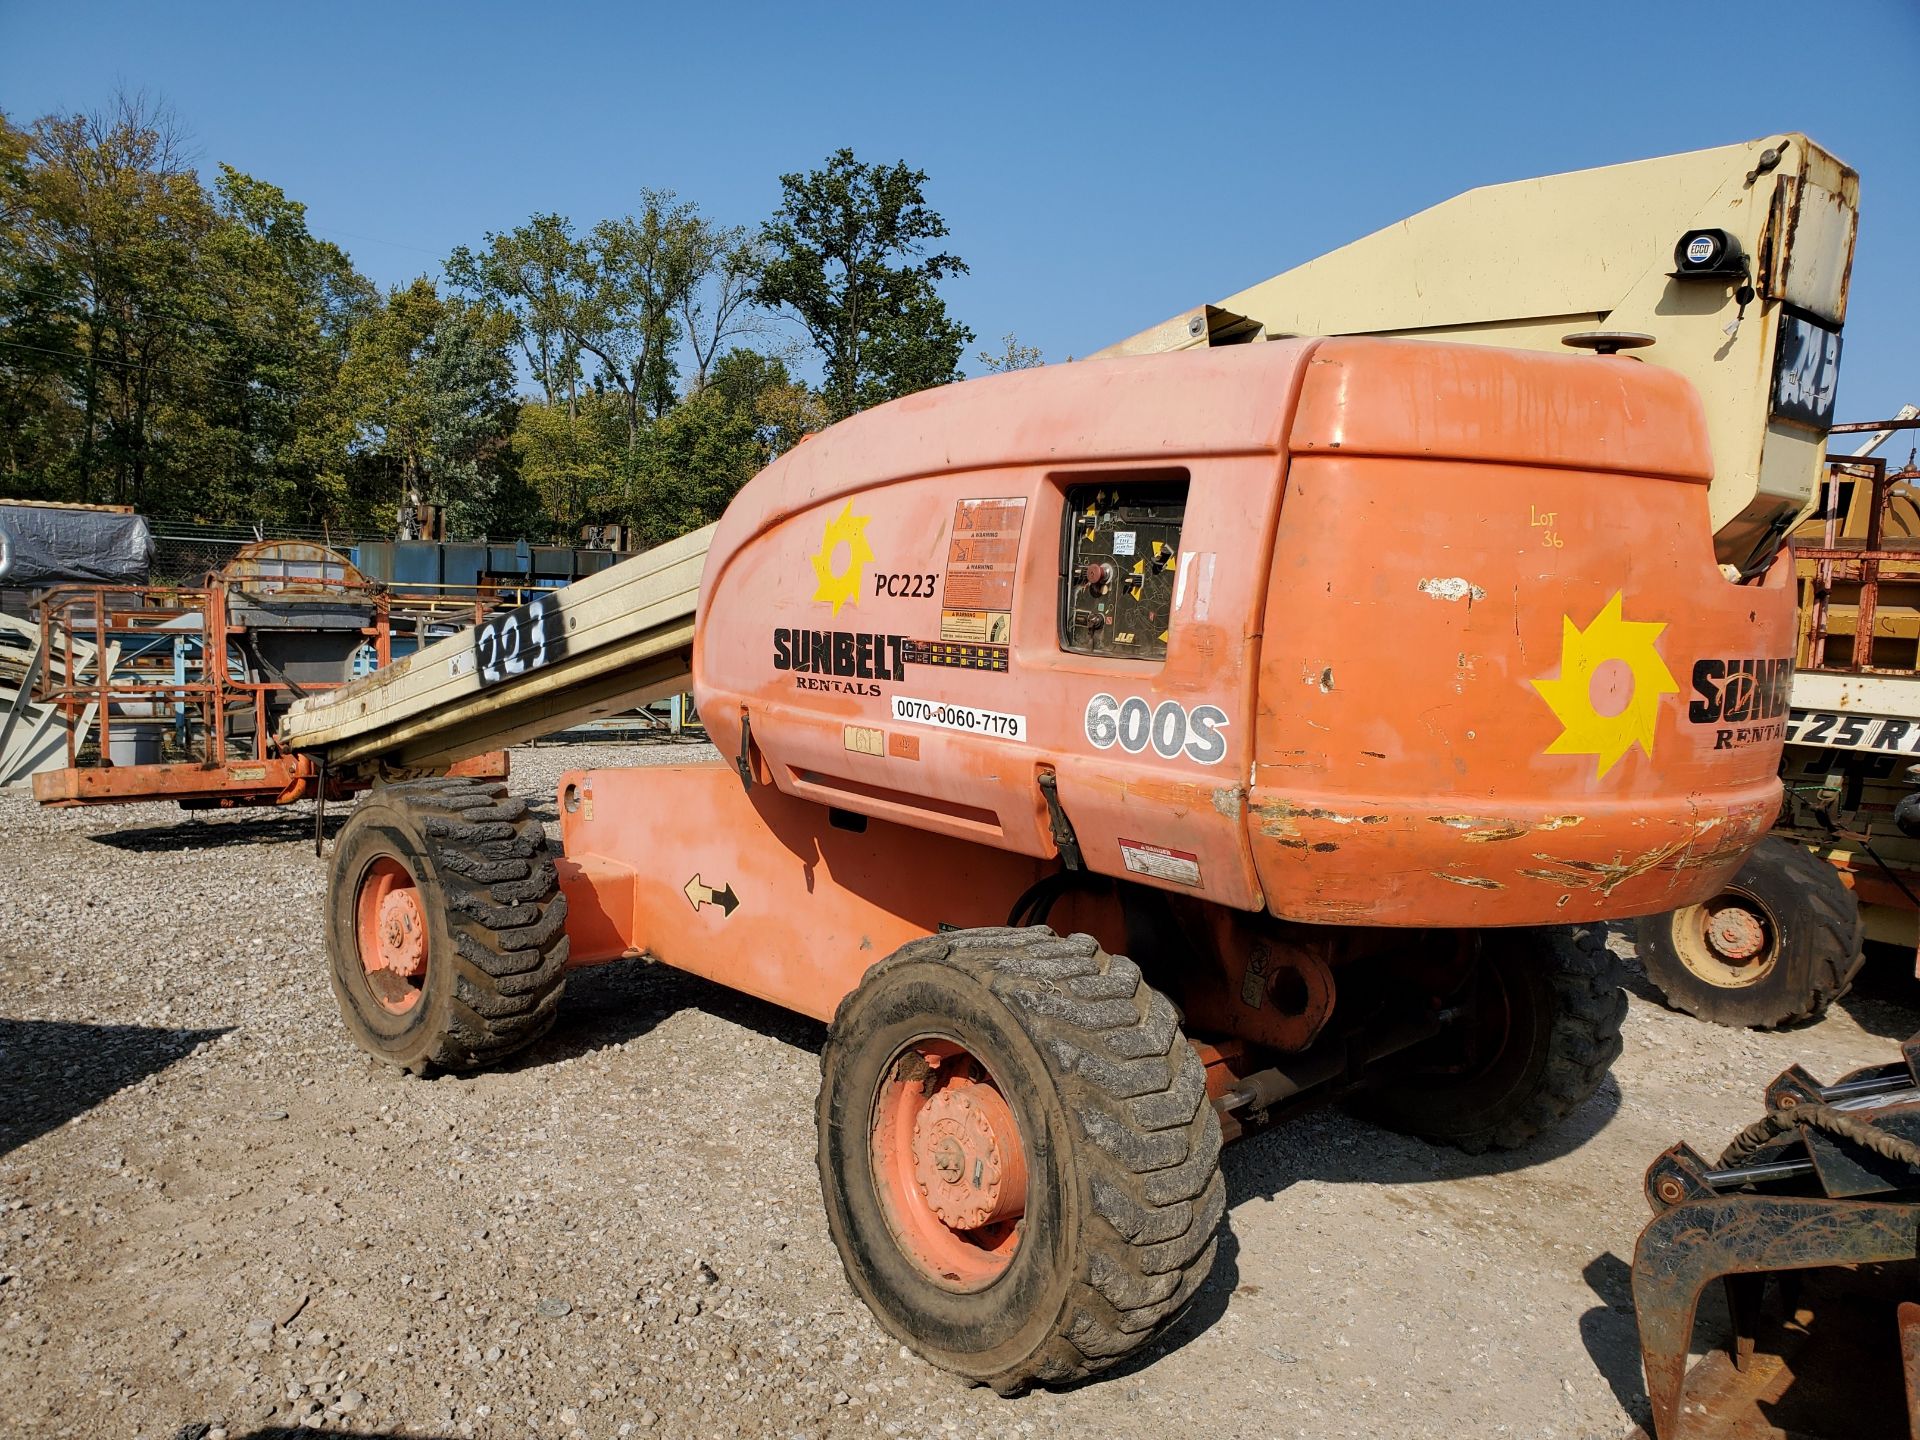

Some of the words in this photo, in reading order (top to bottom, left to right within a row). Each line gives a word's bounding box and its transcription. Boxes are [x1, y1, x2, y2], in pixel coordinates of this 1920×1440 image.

[1690, 244, 1710, 254] ECCO
[1541, 530, 1564, 548] 36
[478, 601, 547, 682] 223
[1115, 632, 1135, 643] JLG
[773, 628, 910, 682] SUNBELT
[796, 676, 882, 697] RENTALS
[1689, 658, 1796, 723] SUNB
[897, 700, 1018, 736] 0070-0060-7179
[1084, 692, 1230, 765] 600S
[1145, 845, 1171, 856] DANGER
